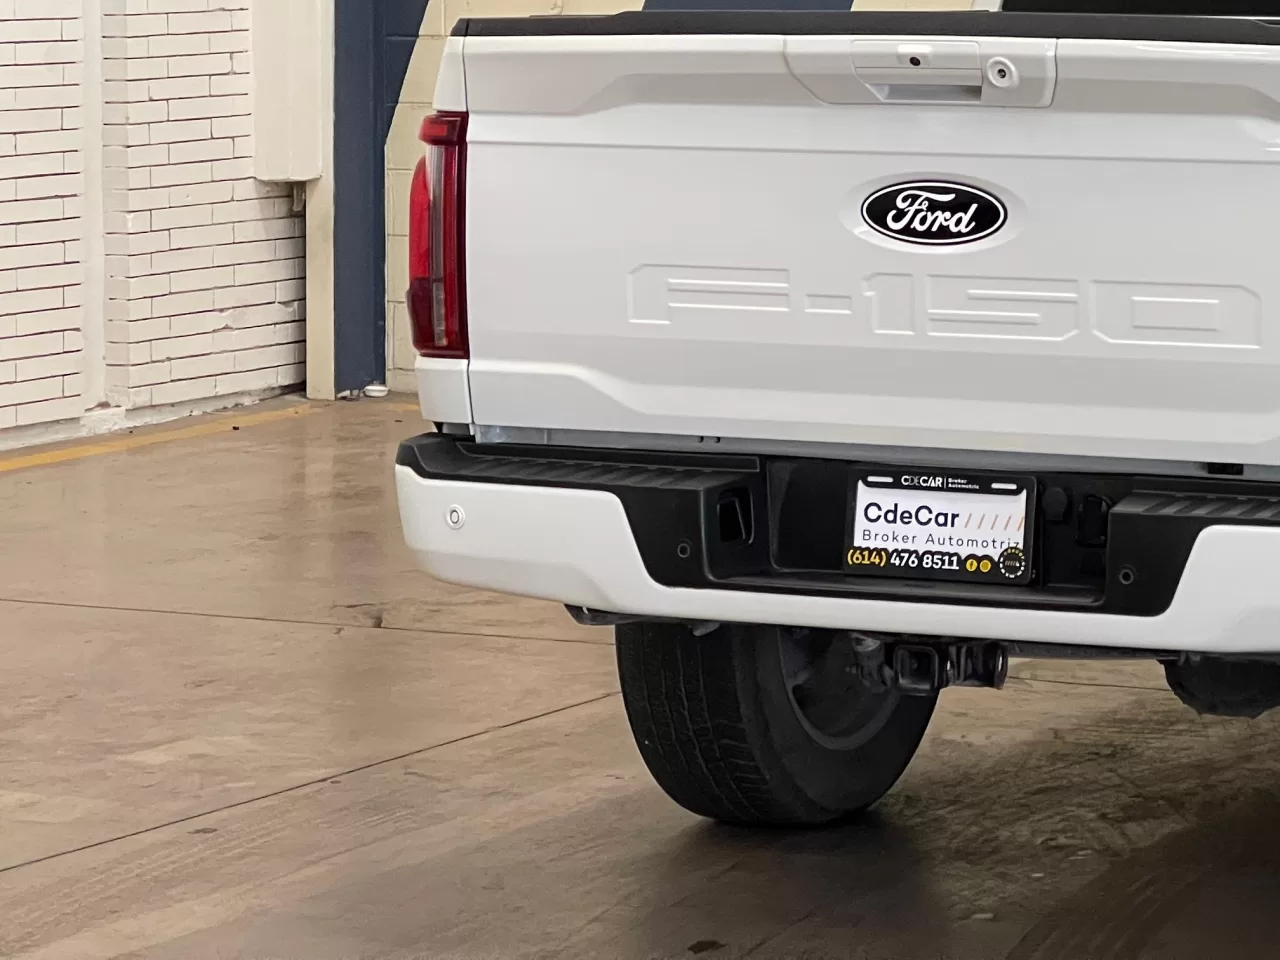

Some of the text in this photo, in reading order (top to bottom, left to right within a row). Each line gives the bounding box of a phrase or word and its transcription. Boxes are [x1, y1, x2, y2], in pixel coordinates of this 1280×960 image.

[886, 189, 979, 233] Ford
[627, 262, 1263, 348] F-150
[863, 501, 960, 528] CdeCar
[862, 529, 1020, 549] Broker Automotriz
[847, 549, 960, 570] (614) 476 8511
